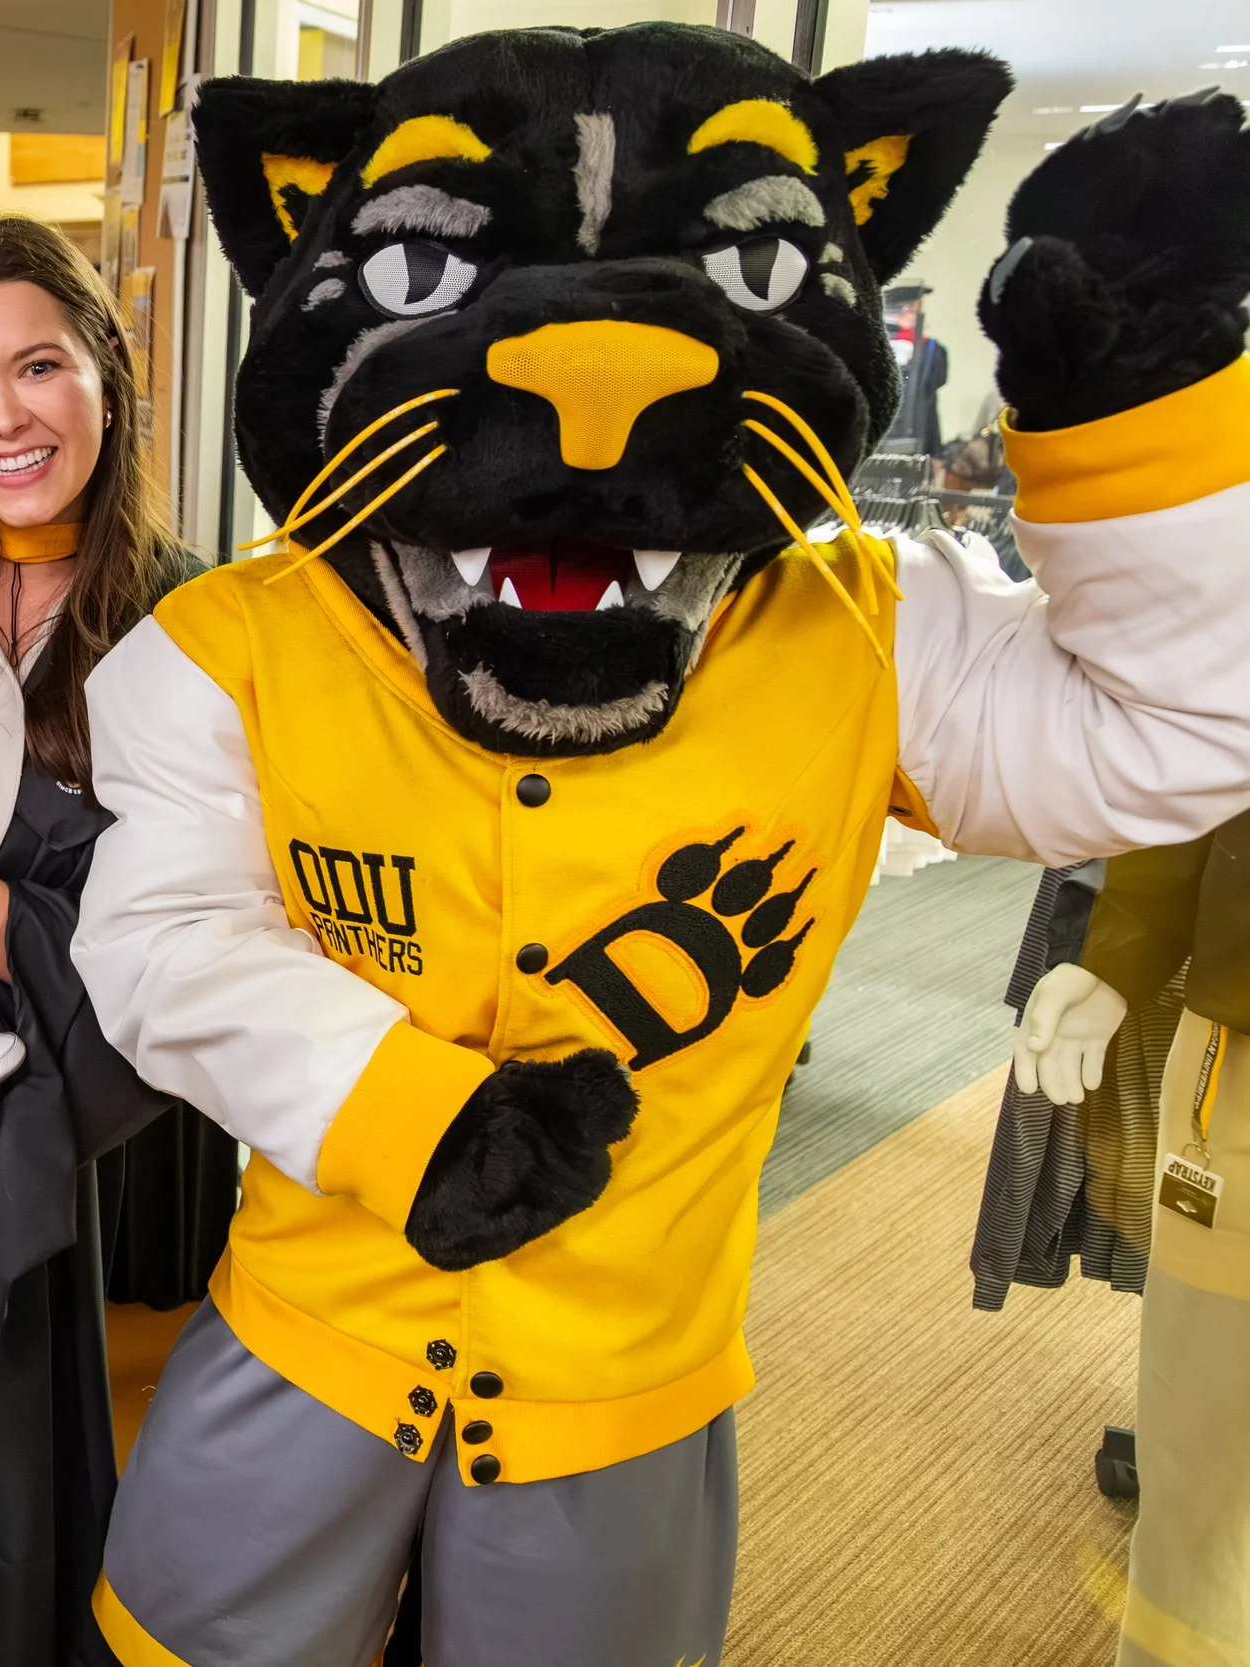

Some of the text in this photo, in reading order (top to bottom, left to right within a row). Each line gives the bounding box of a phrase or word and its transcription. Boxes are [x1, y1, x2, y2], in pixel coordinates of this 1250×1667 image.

[288, 838, 417, 937] ODU
[309, 911, 423, 976] PANTHERS
[1168, 1160, 1217, 1193] KEYSTRAP
